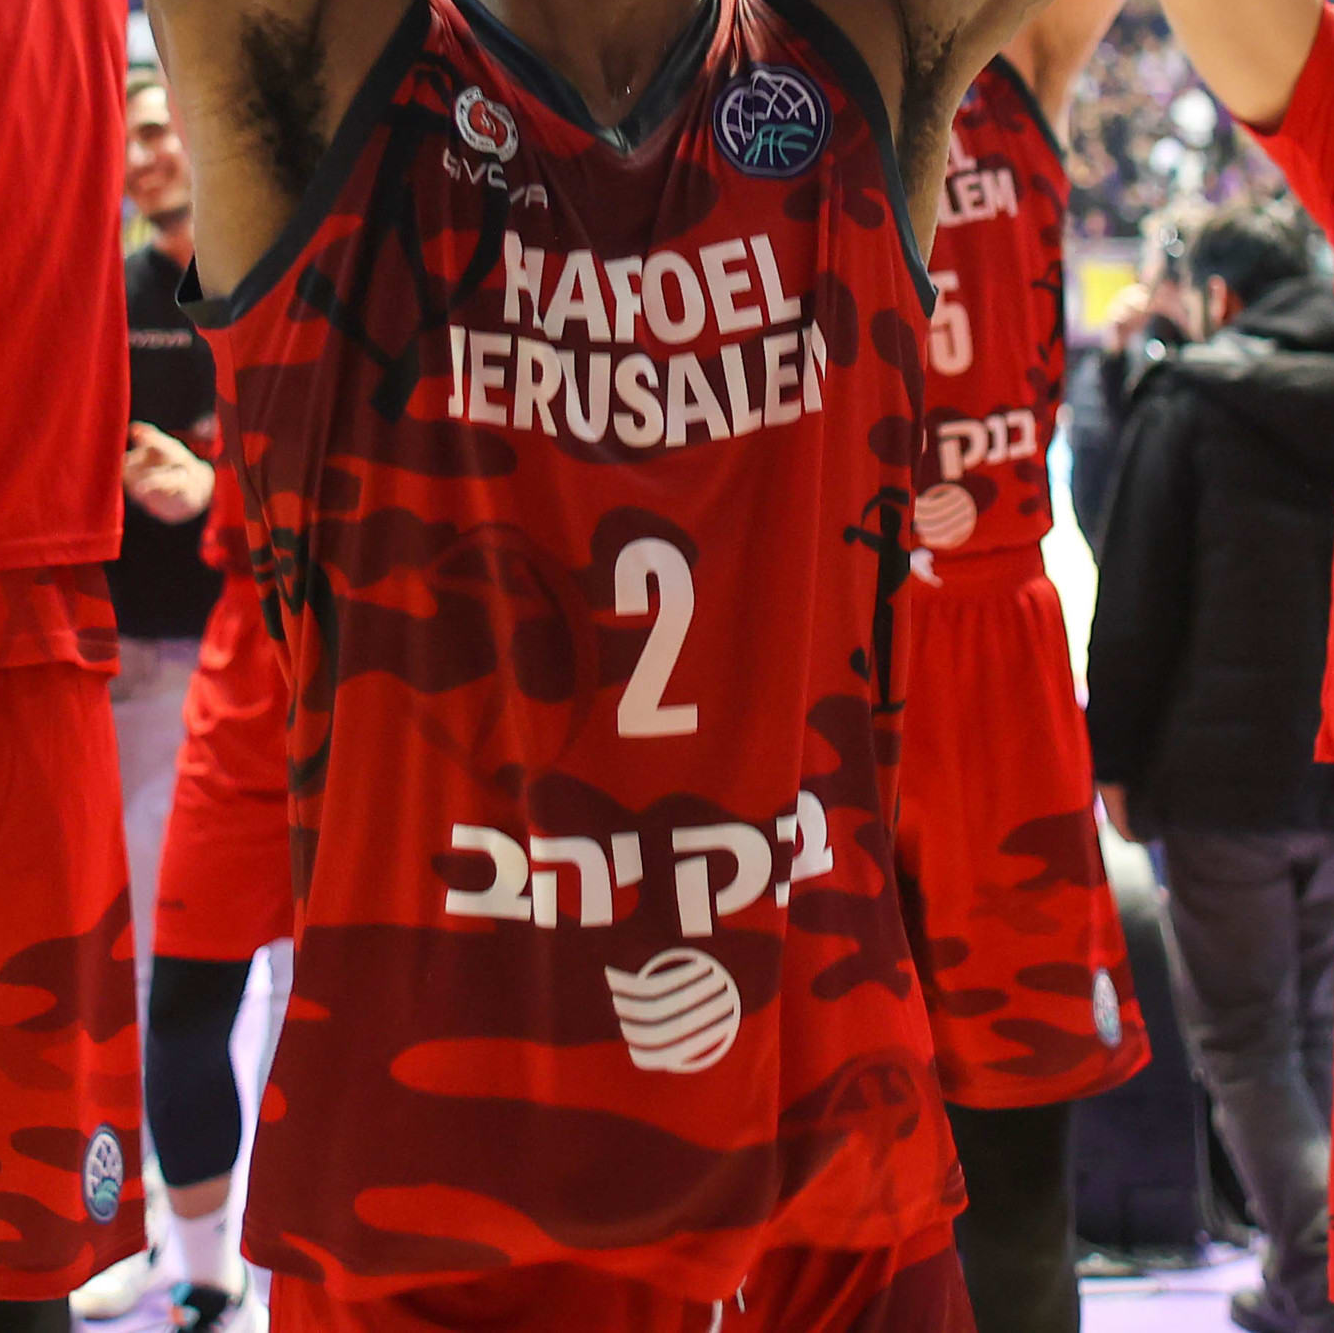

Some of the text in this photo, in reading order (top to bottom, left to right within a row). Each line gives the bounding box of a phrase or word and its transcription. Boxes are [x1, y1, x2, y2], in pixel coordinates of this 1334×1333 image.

[937, 408, 1037, 482] בנק
[614, 537, 698, 738] 2
[445, 822, 644, 928] יהב
